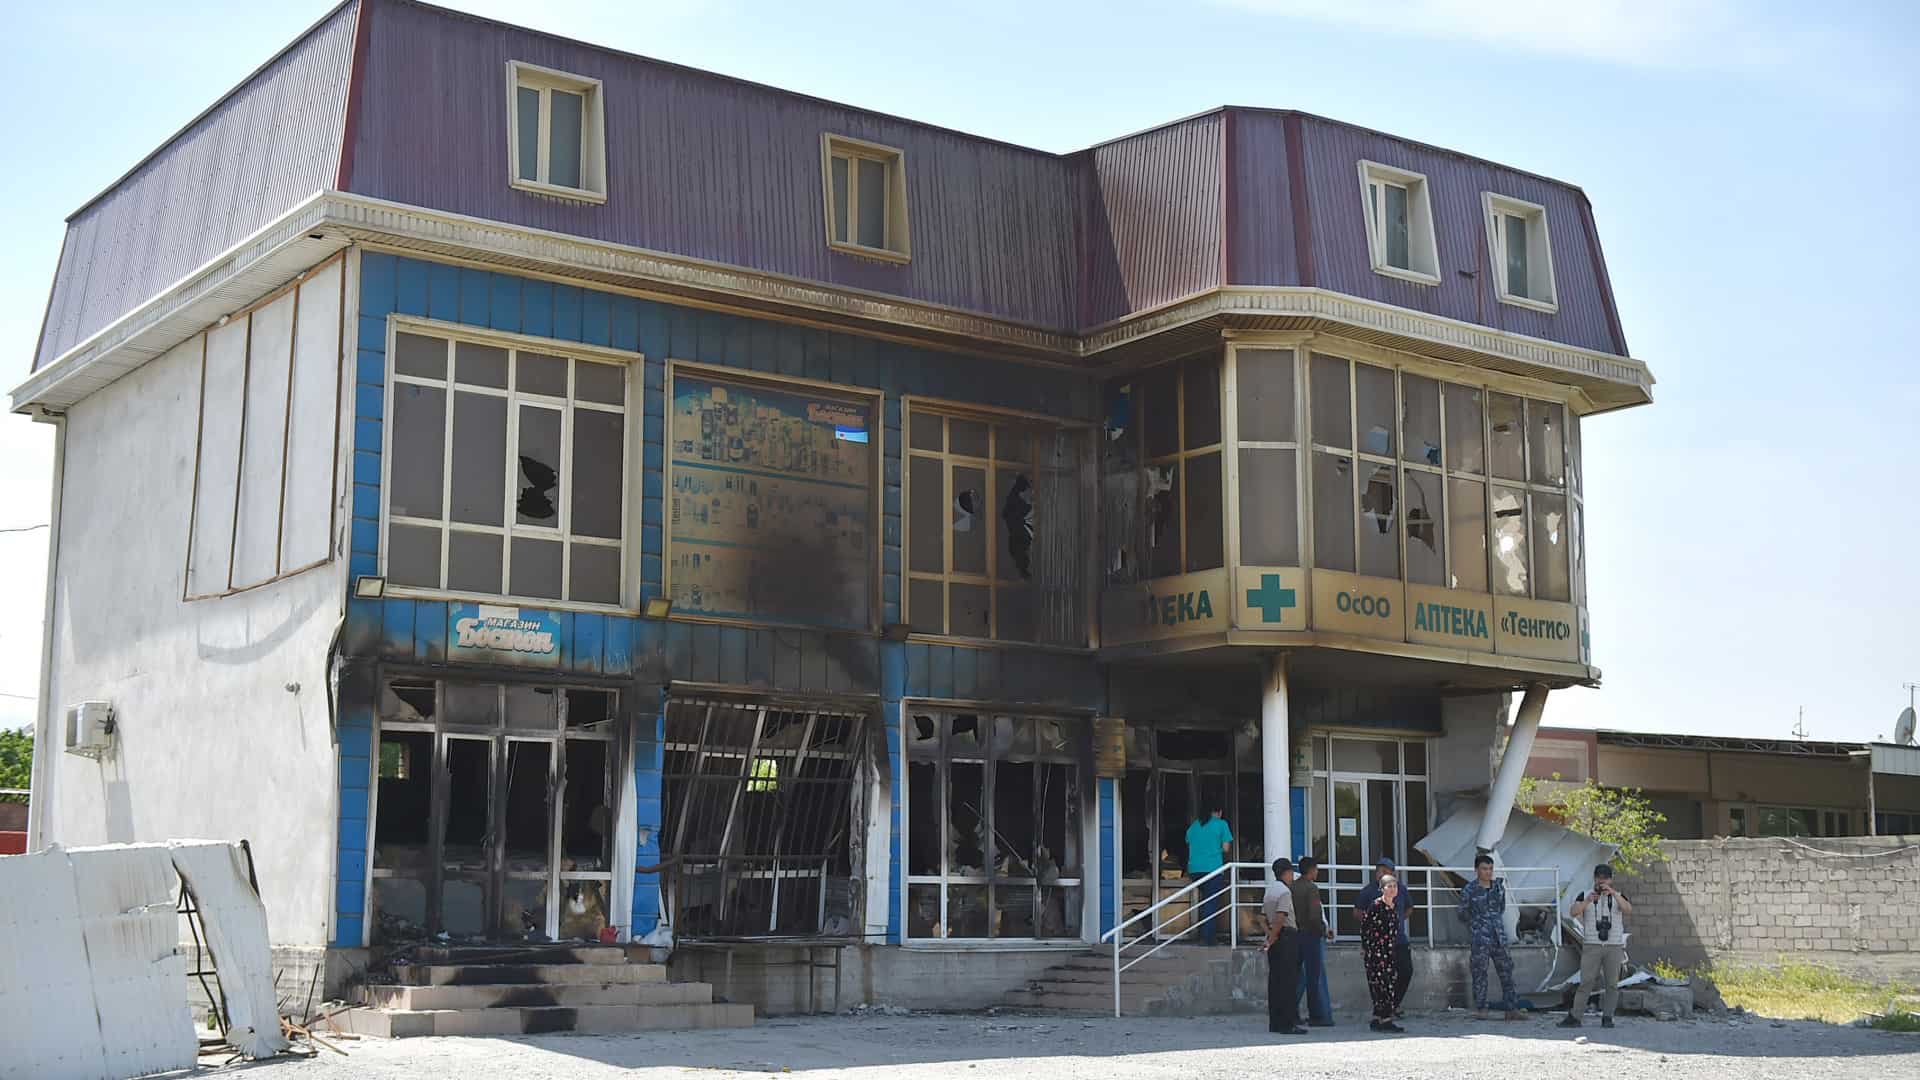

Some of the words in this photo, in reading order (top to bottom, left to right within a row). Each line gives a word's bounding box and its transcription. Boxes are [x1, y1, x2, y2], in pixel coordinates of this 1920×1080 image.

[486, 617, 541, 631] МАГАЗИН
[1336, 591, 1391, 618] ОсОО
[1414, 602, 1489, 639] АПТЕКА
[1500, 611, 1570, 641] «Тенгис»
